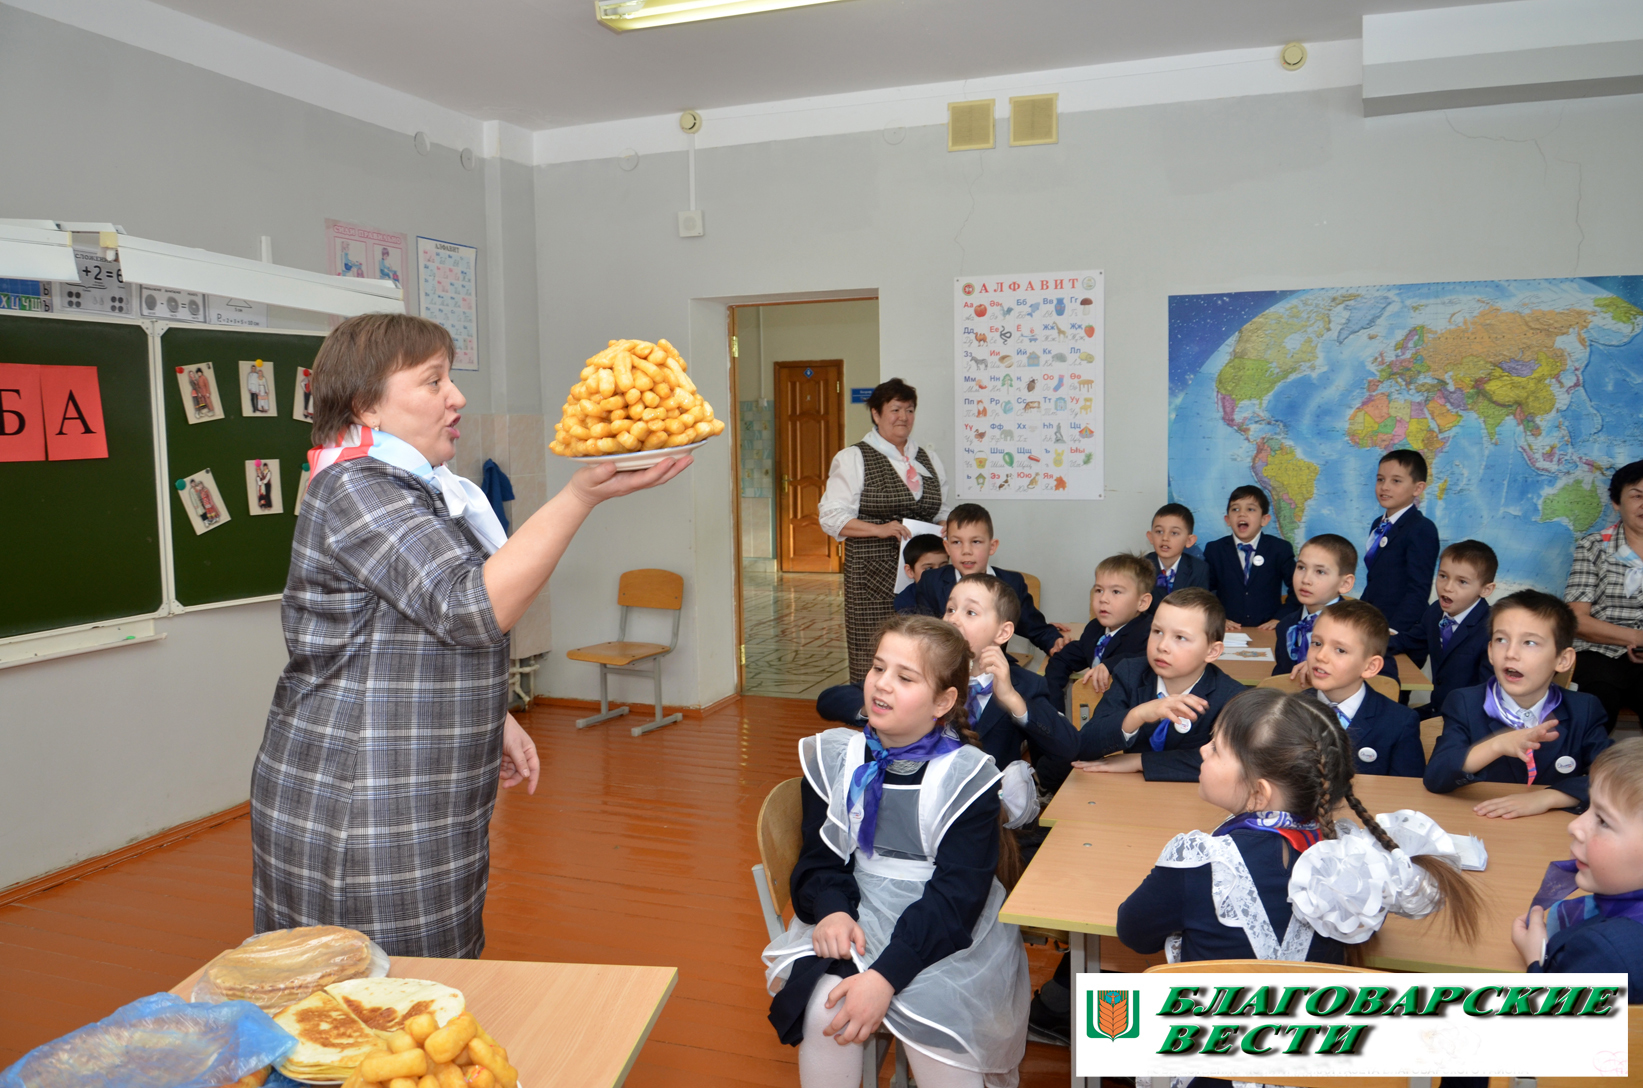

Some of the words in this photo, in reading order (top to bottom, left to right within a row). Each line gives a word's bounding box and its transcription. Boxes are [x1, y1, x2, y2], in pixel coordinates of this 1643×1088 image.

[979, 278, 1079, 293] АЛФАВИТ
[0, 294, 8, 308] Х
[22, 297, 29, 310] Ч
[963, 326, 974, 335] Дд
[990, 325, 1000, 333] Ее
[1042, 323, 1055, 331] Жж
[963, 350, 973, 358] Зз
[990, 349, 1001, 357] Ии
[1016, 347, 1027, 356] Йй
[1042, 347, 1052, 355] Кк
[1070, 346, 1081, 354] Лл
[990, 374, 1001, 382] Нн
[1042, 373, 1055, 381] Оо
[964, 397, 975, 405] Пп
[990, 397, 1001, 406] Рр
[1016, 396, 1027, 404] Сс
[1070, 396, 1080, 405] Уу
[990, 423, 1004, 431] Фф
[1016, 422, 1027, 430] Хх
[1070, 421, 1082, 430] Цц
[1016, 447, 1032, 455] Щщ
[1070, 446, 1086, 454] Ыы
[990, 472, 1001, 480] Ээ
[1016, 471, 1033, 479] Юю
[1042, 472, 1054, 480] Яя
